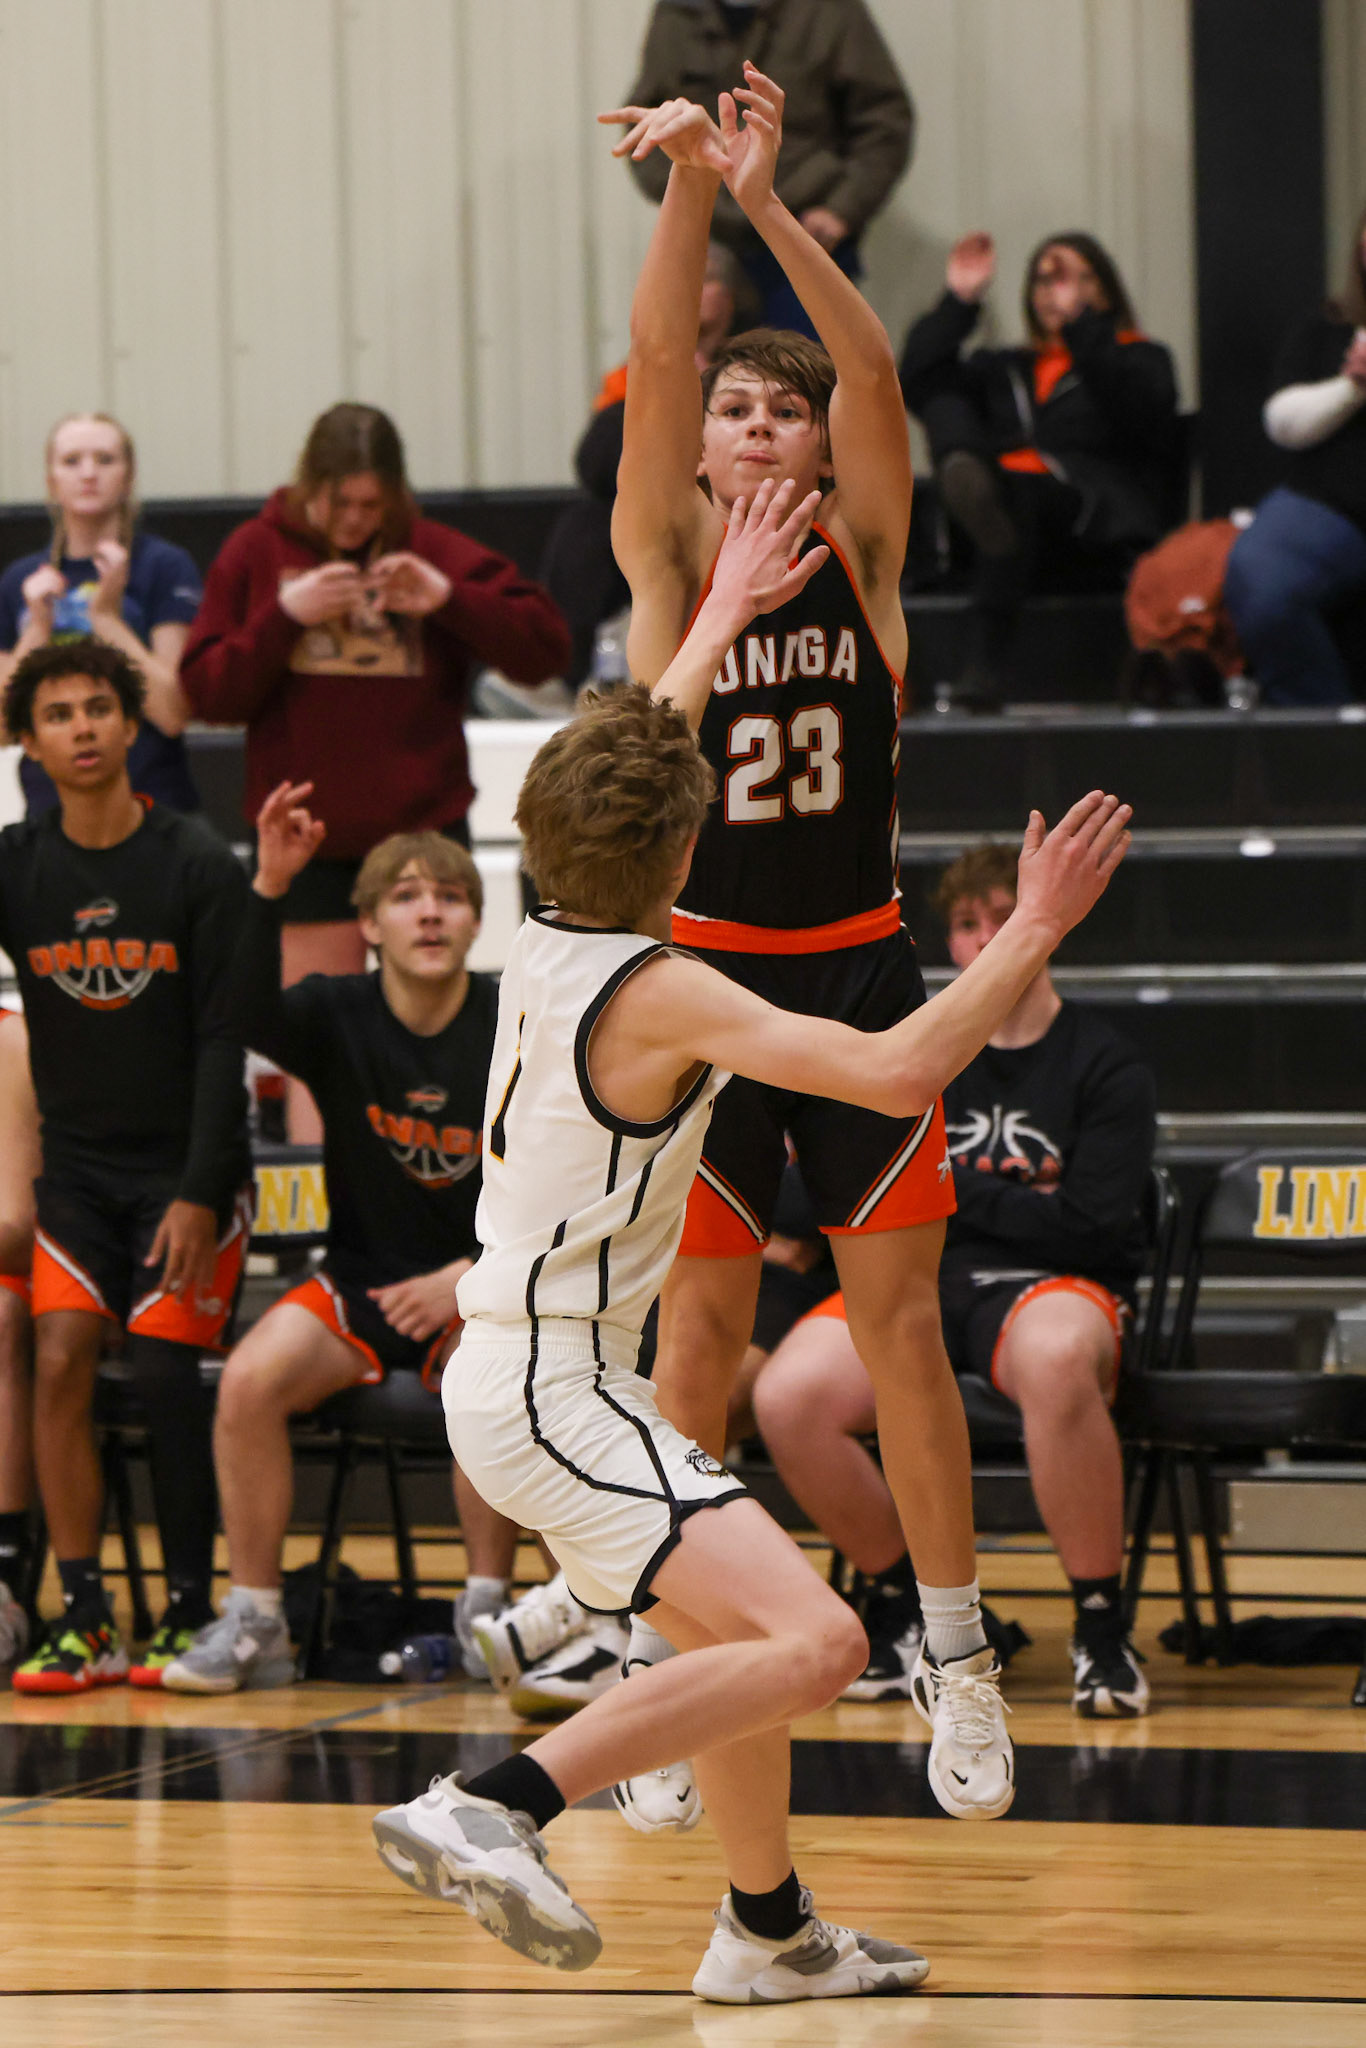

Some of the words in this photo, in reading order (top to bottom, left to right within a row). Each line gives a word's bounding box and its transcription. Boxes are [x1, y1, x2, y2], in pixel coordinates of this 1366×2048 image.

[724, 702, 844, 825] 23
[27, 937, 179, 976] ONAGA
[366, 1104, 483, 1155] ONAG
[251, 1164, 331, 1236] NN
